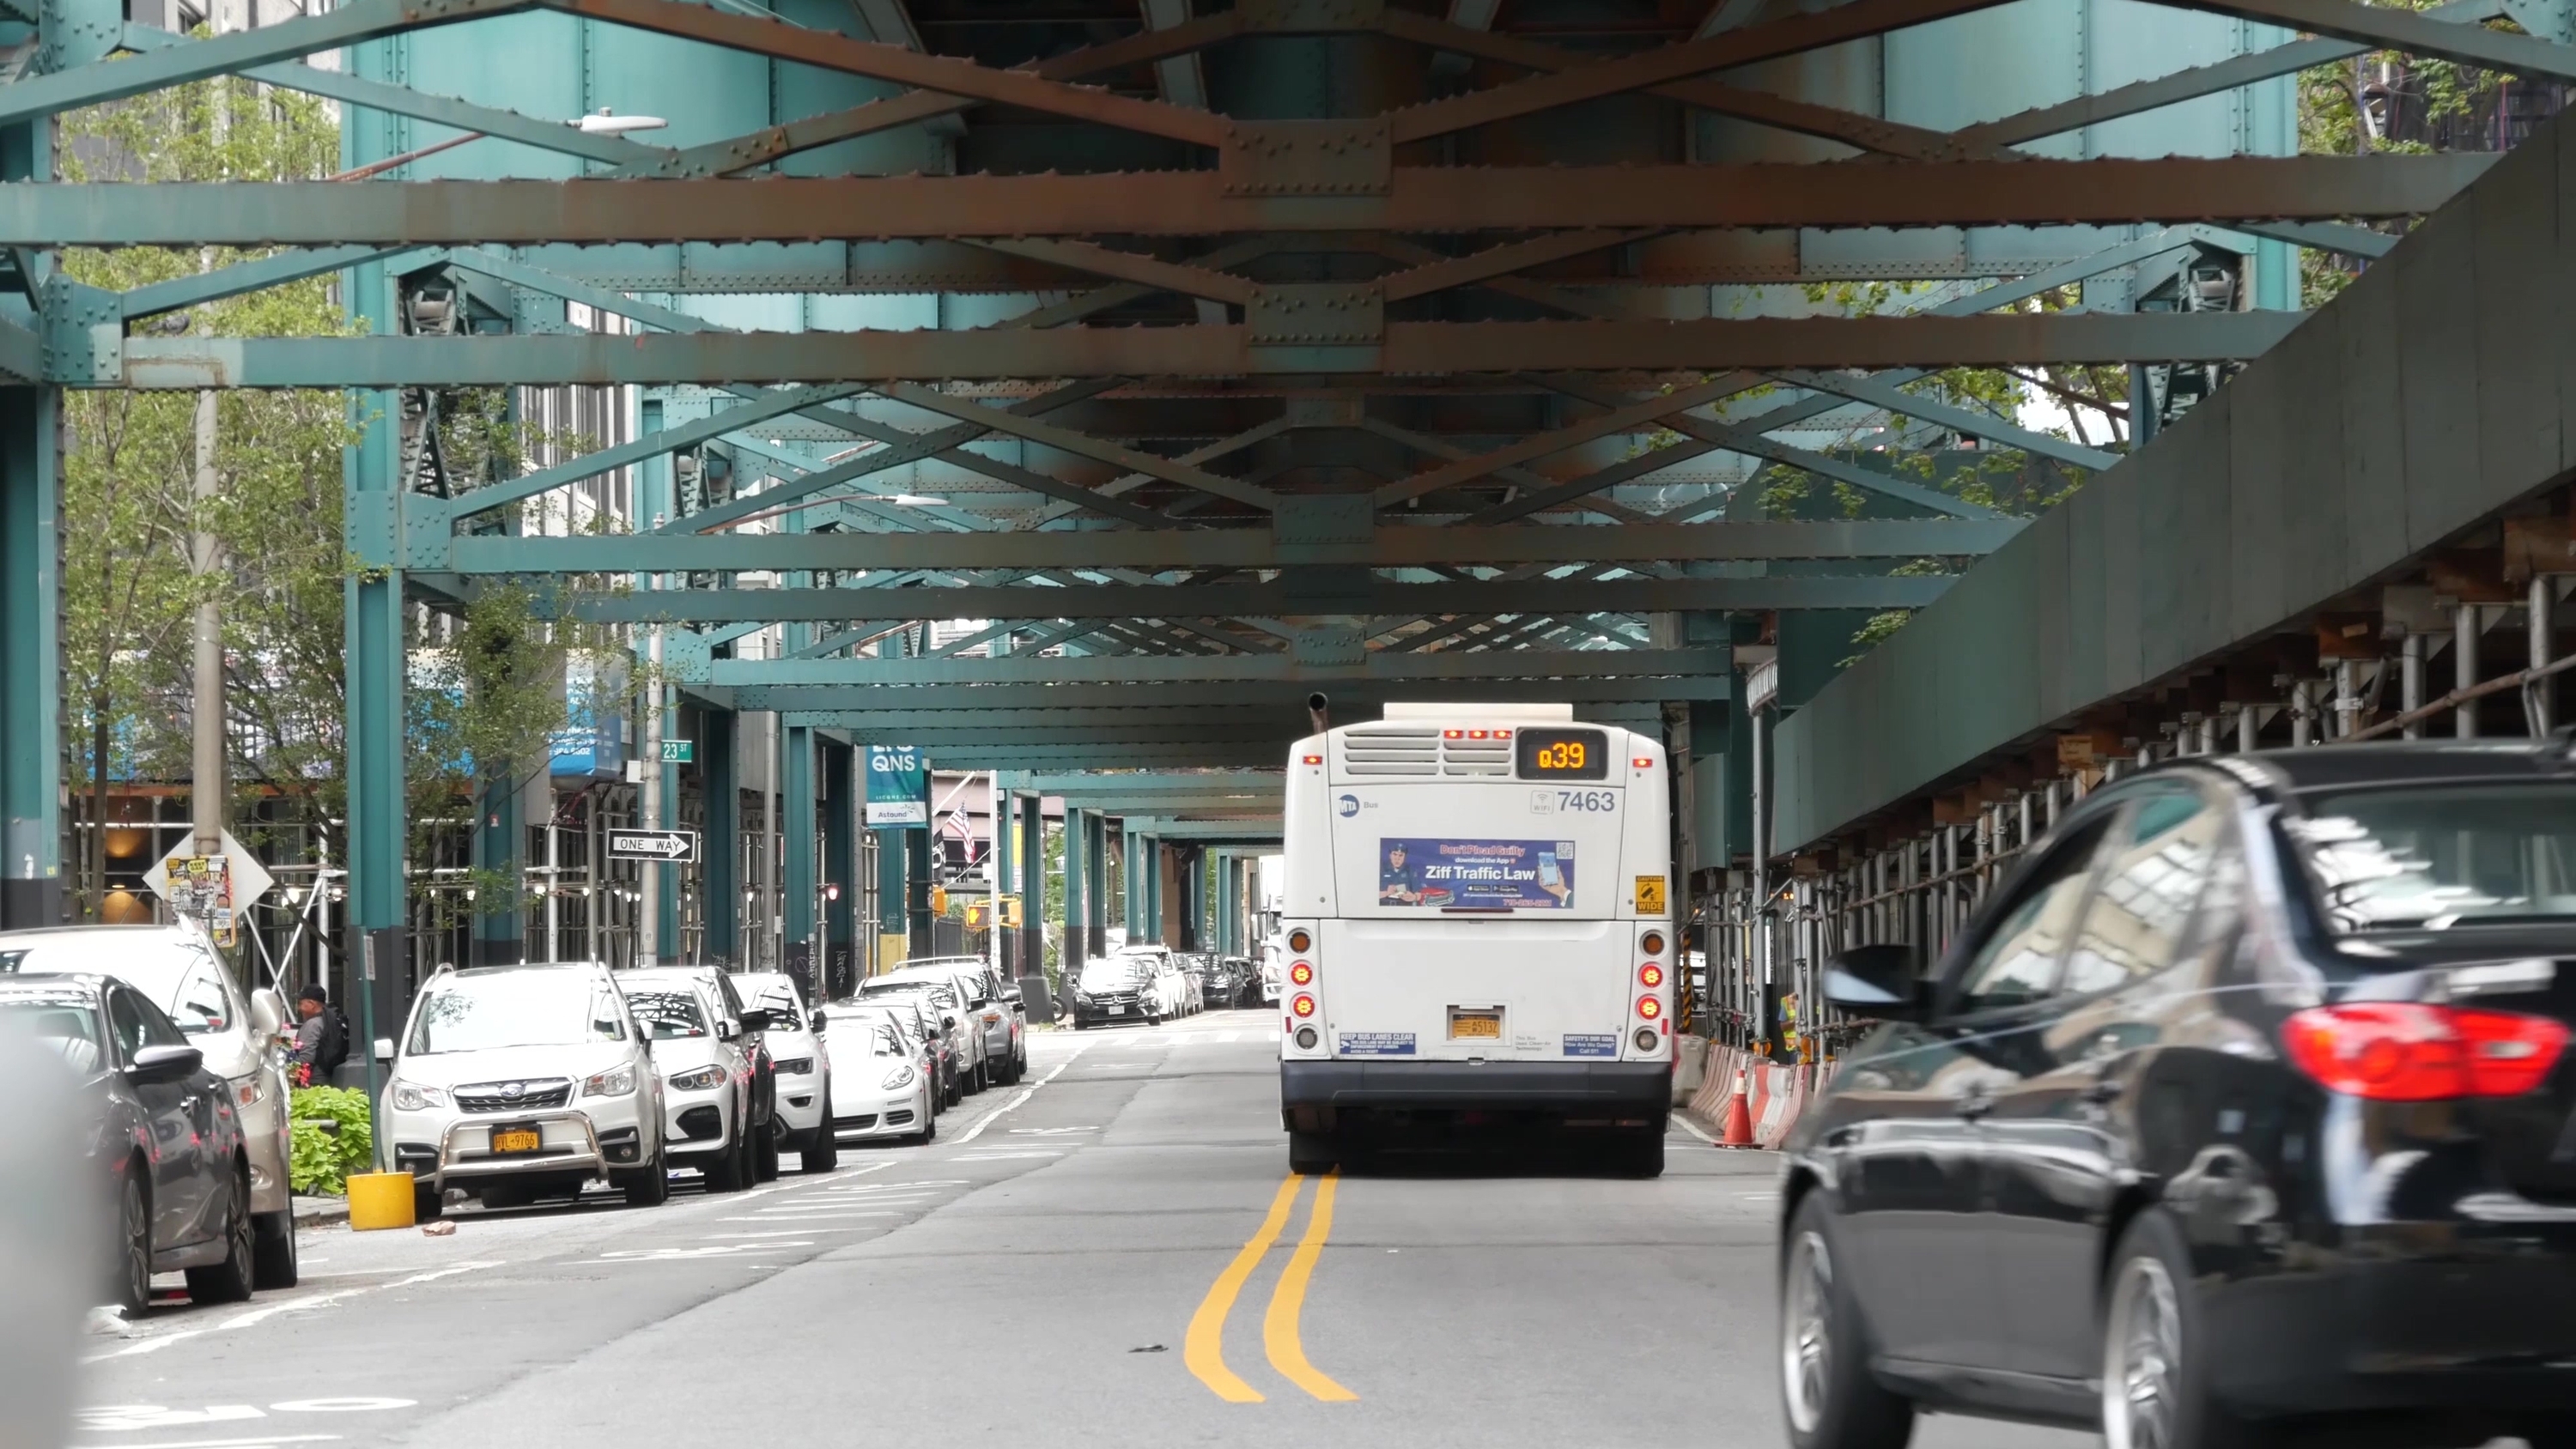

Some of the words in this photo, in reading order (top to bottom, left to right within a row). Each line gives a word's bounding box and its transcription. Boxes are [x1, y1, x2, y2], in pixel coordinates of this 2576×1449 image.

[664, 743, 677, 759] 23
[1540, 743, 1584, 768] Q39
[872, 755, 915, 772] QNS
[1558, 791, 1615, 812] 7463
[620, 839, 645, 850] ONE
[655, 840, 681, 851] WAY
[1440, 844, 1466, 855] Don't
[1467, 845, 1495, 855] Plead
[1496, 845, 1526, 857] Guilty
[1425, 865, 1451, 880] Ziff
[1453, 866, 1502, 880] Traffic
[1504, 867, 1535, 880] Law
